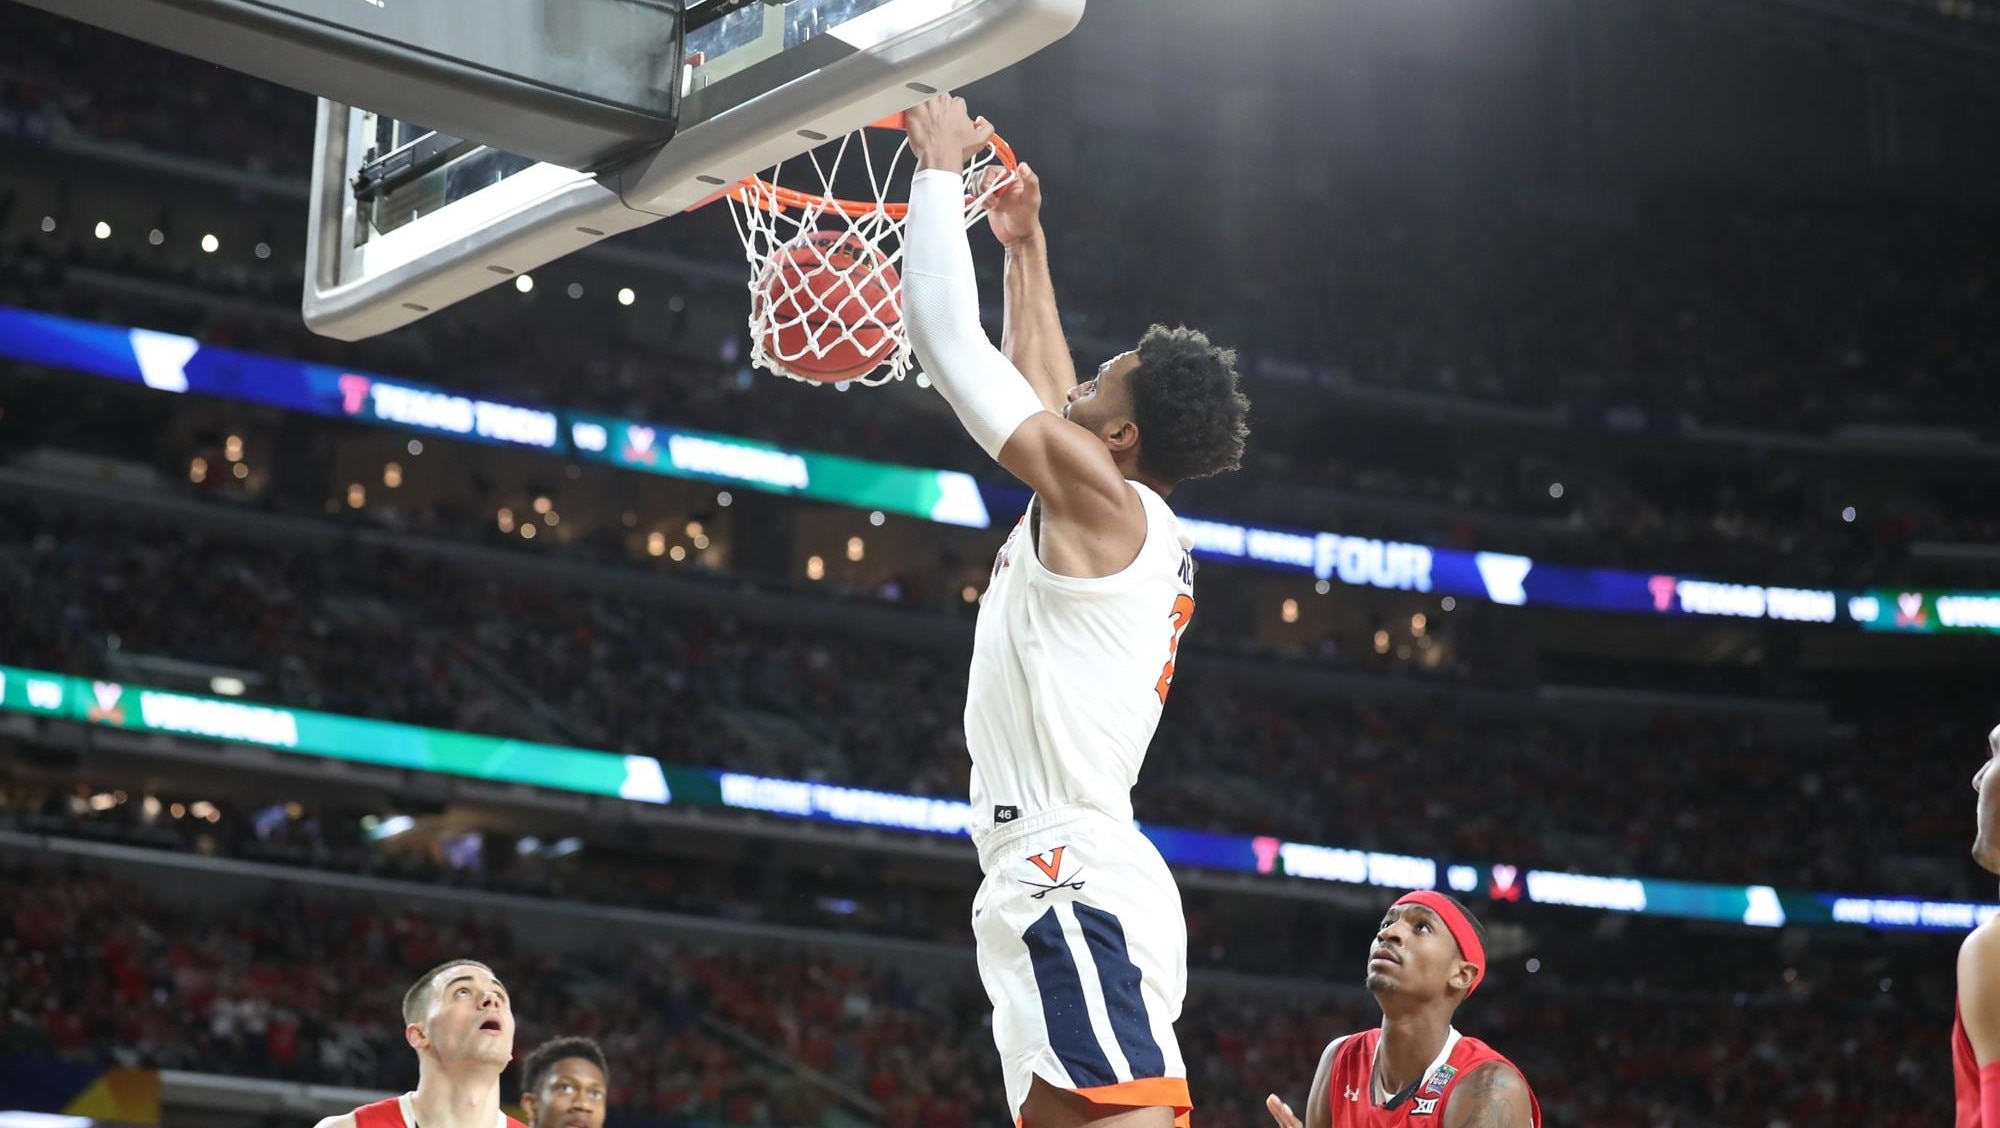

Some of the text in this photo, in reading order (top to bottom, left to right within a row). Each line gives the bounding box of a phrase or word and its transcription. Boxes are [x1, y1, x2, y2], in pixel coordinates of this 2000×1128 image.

[1314, 532, 1433, 593] FOUR
[998, 810, 1012, 819] 46
[1026, 845, 1067, 883] V
